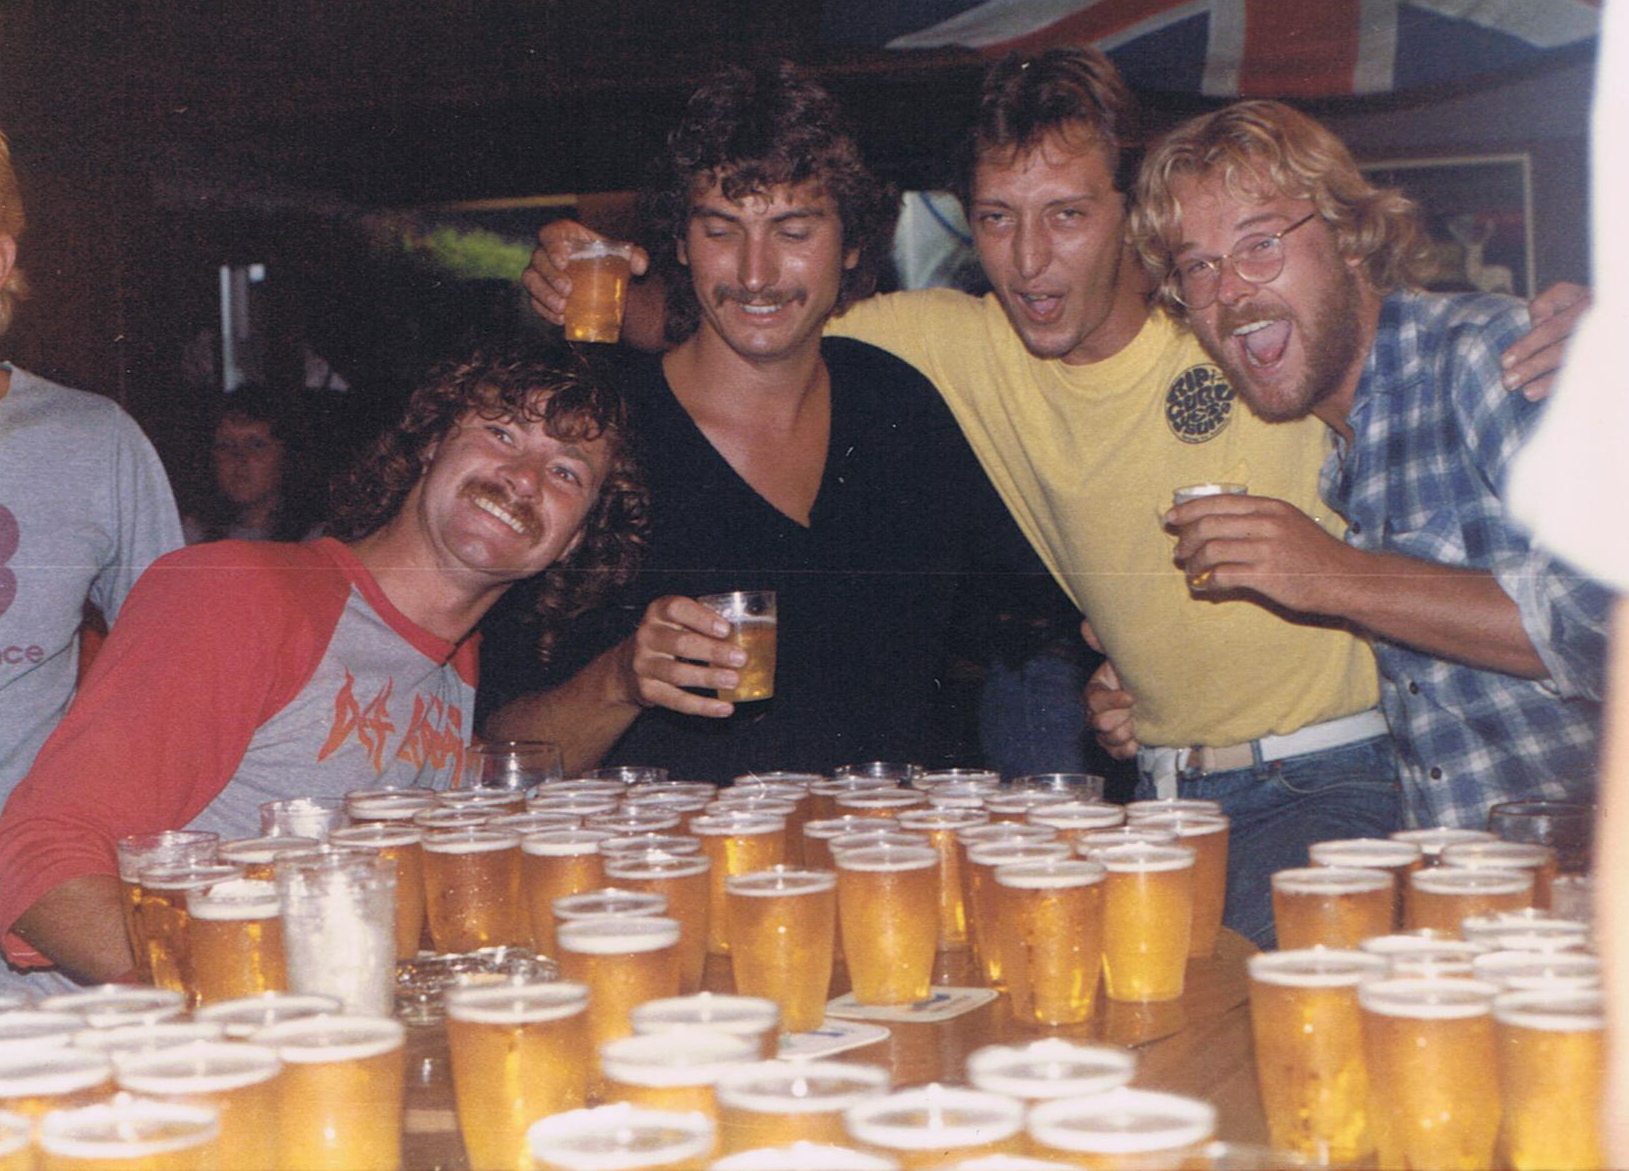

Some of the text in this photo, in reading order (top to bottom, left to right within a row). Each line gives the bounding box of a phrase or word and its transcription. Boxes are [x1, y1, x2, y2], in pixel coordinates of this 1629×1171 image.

[1166, 367, 1209, 403] RIP
[1167, 384, 1237, 421] CURL
[0, 644, 45, 665] ce
